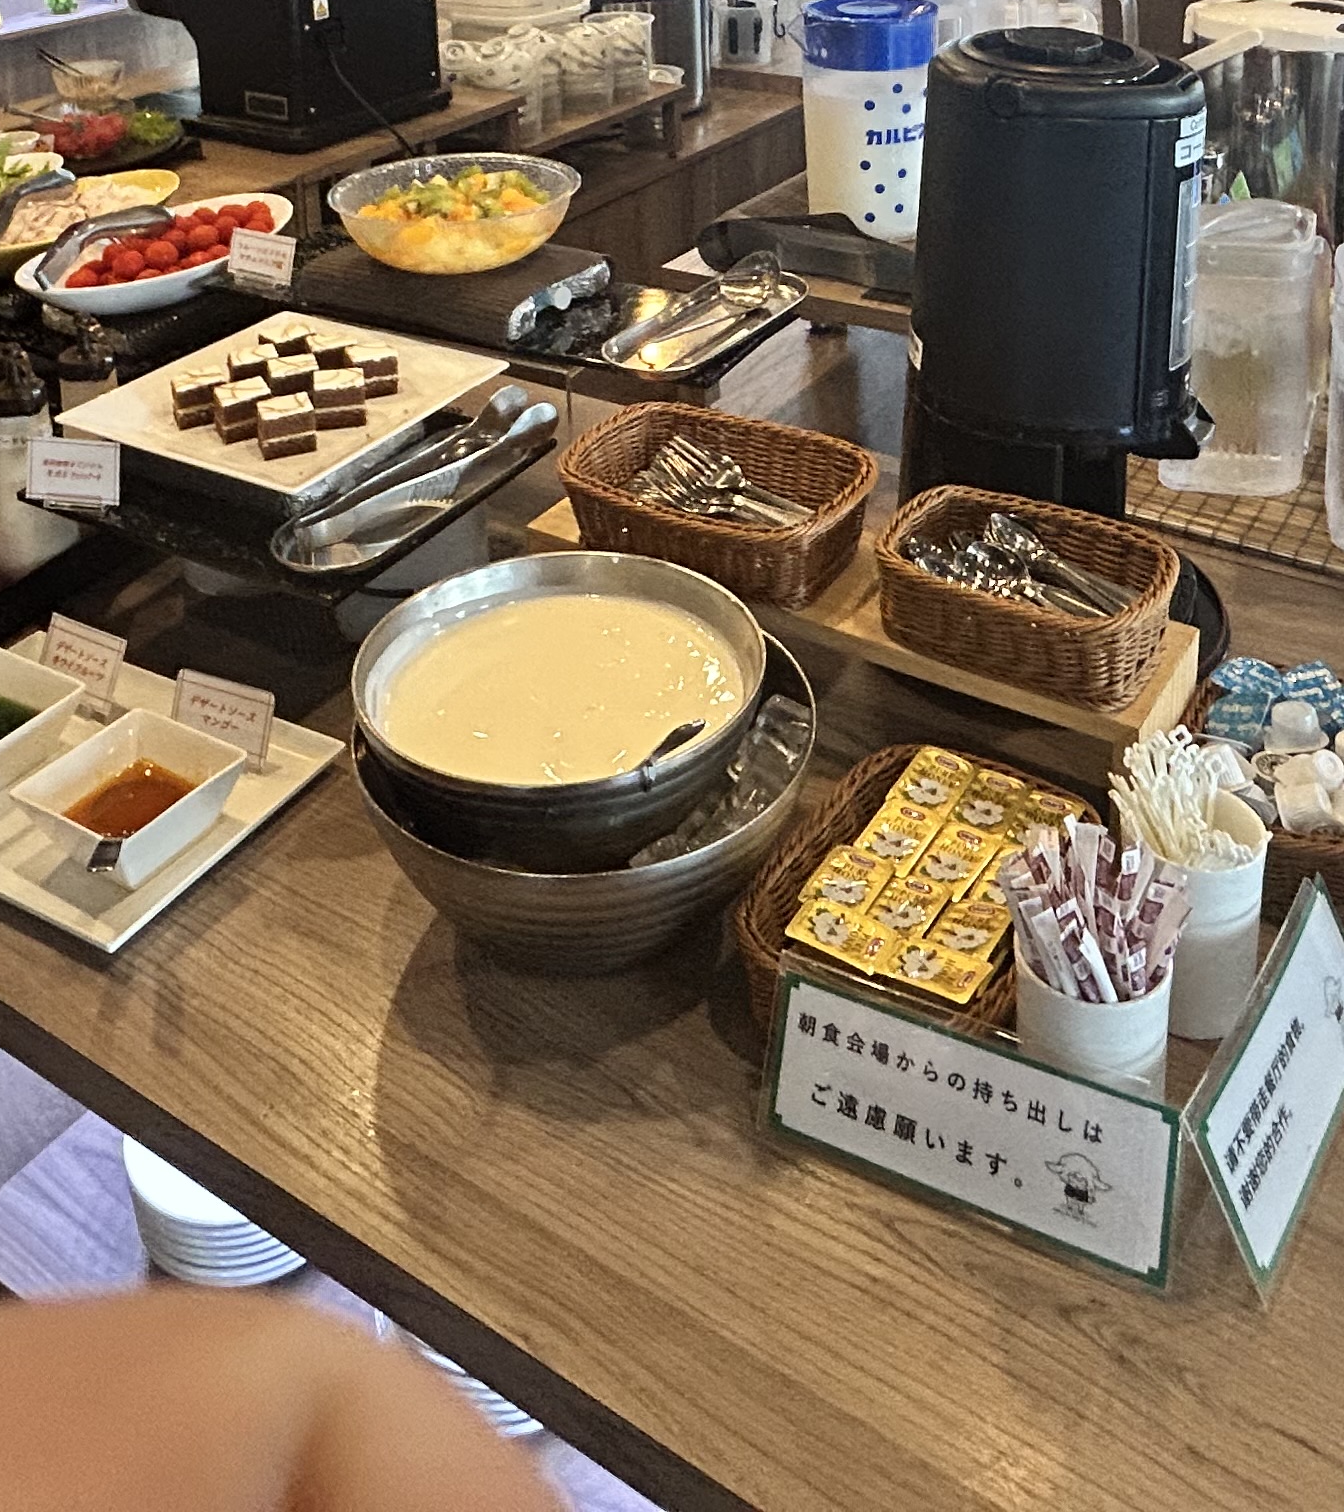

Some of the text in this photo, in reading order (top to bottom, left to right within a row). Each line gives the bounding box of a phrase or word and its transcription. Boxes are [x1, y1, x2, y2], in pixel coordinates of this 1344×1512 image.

[191, 695, 257, 722] デザートソース
[201, 714, 240, 730] マンゴー
[796, 1011, 1104, 1145] 朝食会場からの持ち出しは
[809, 1082, 1024, 1189] ご遠慮願います。
